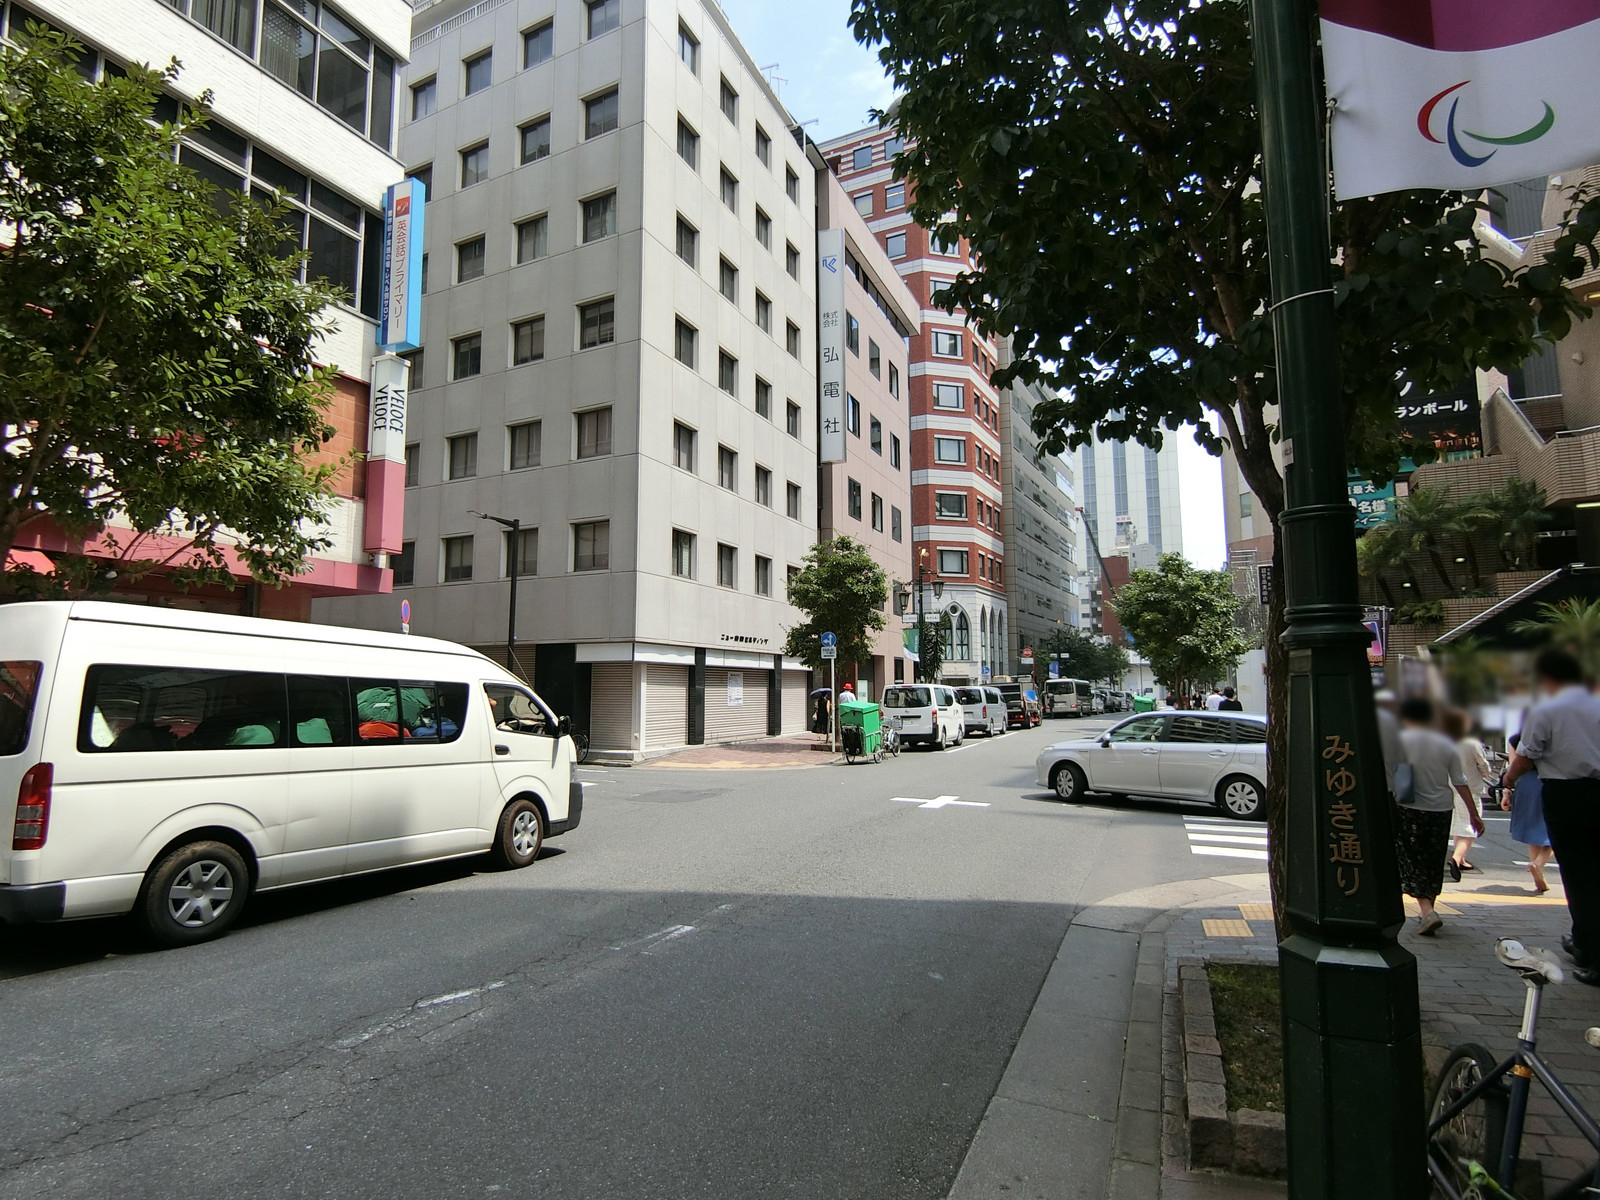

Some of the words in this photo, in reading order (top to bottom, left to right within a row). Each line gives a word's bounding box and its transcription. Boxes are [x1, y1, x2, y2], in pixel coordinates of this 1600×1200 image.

[374, 384, 389, 432] VELOCE
[389, 389, 405, 435] VELOCE
[823, 346, 840, 434] 弘電社
[1394, 399, 1469, 419] ランボール
[1321, 734, 1365, 897] みゆき通り
